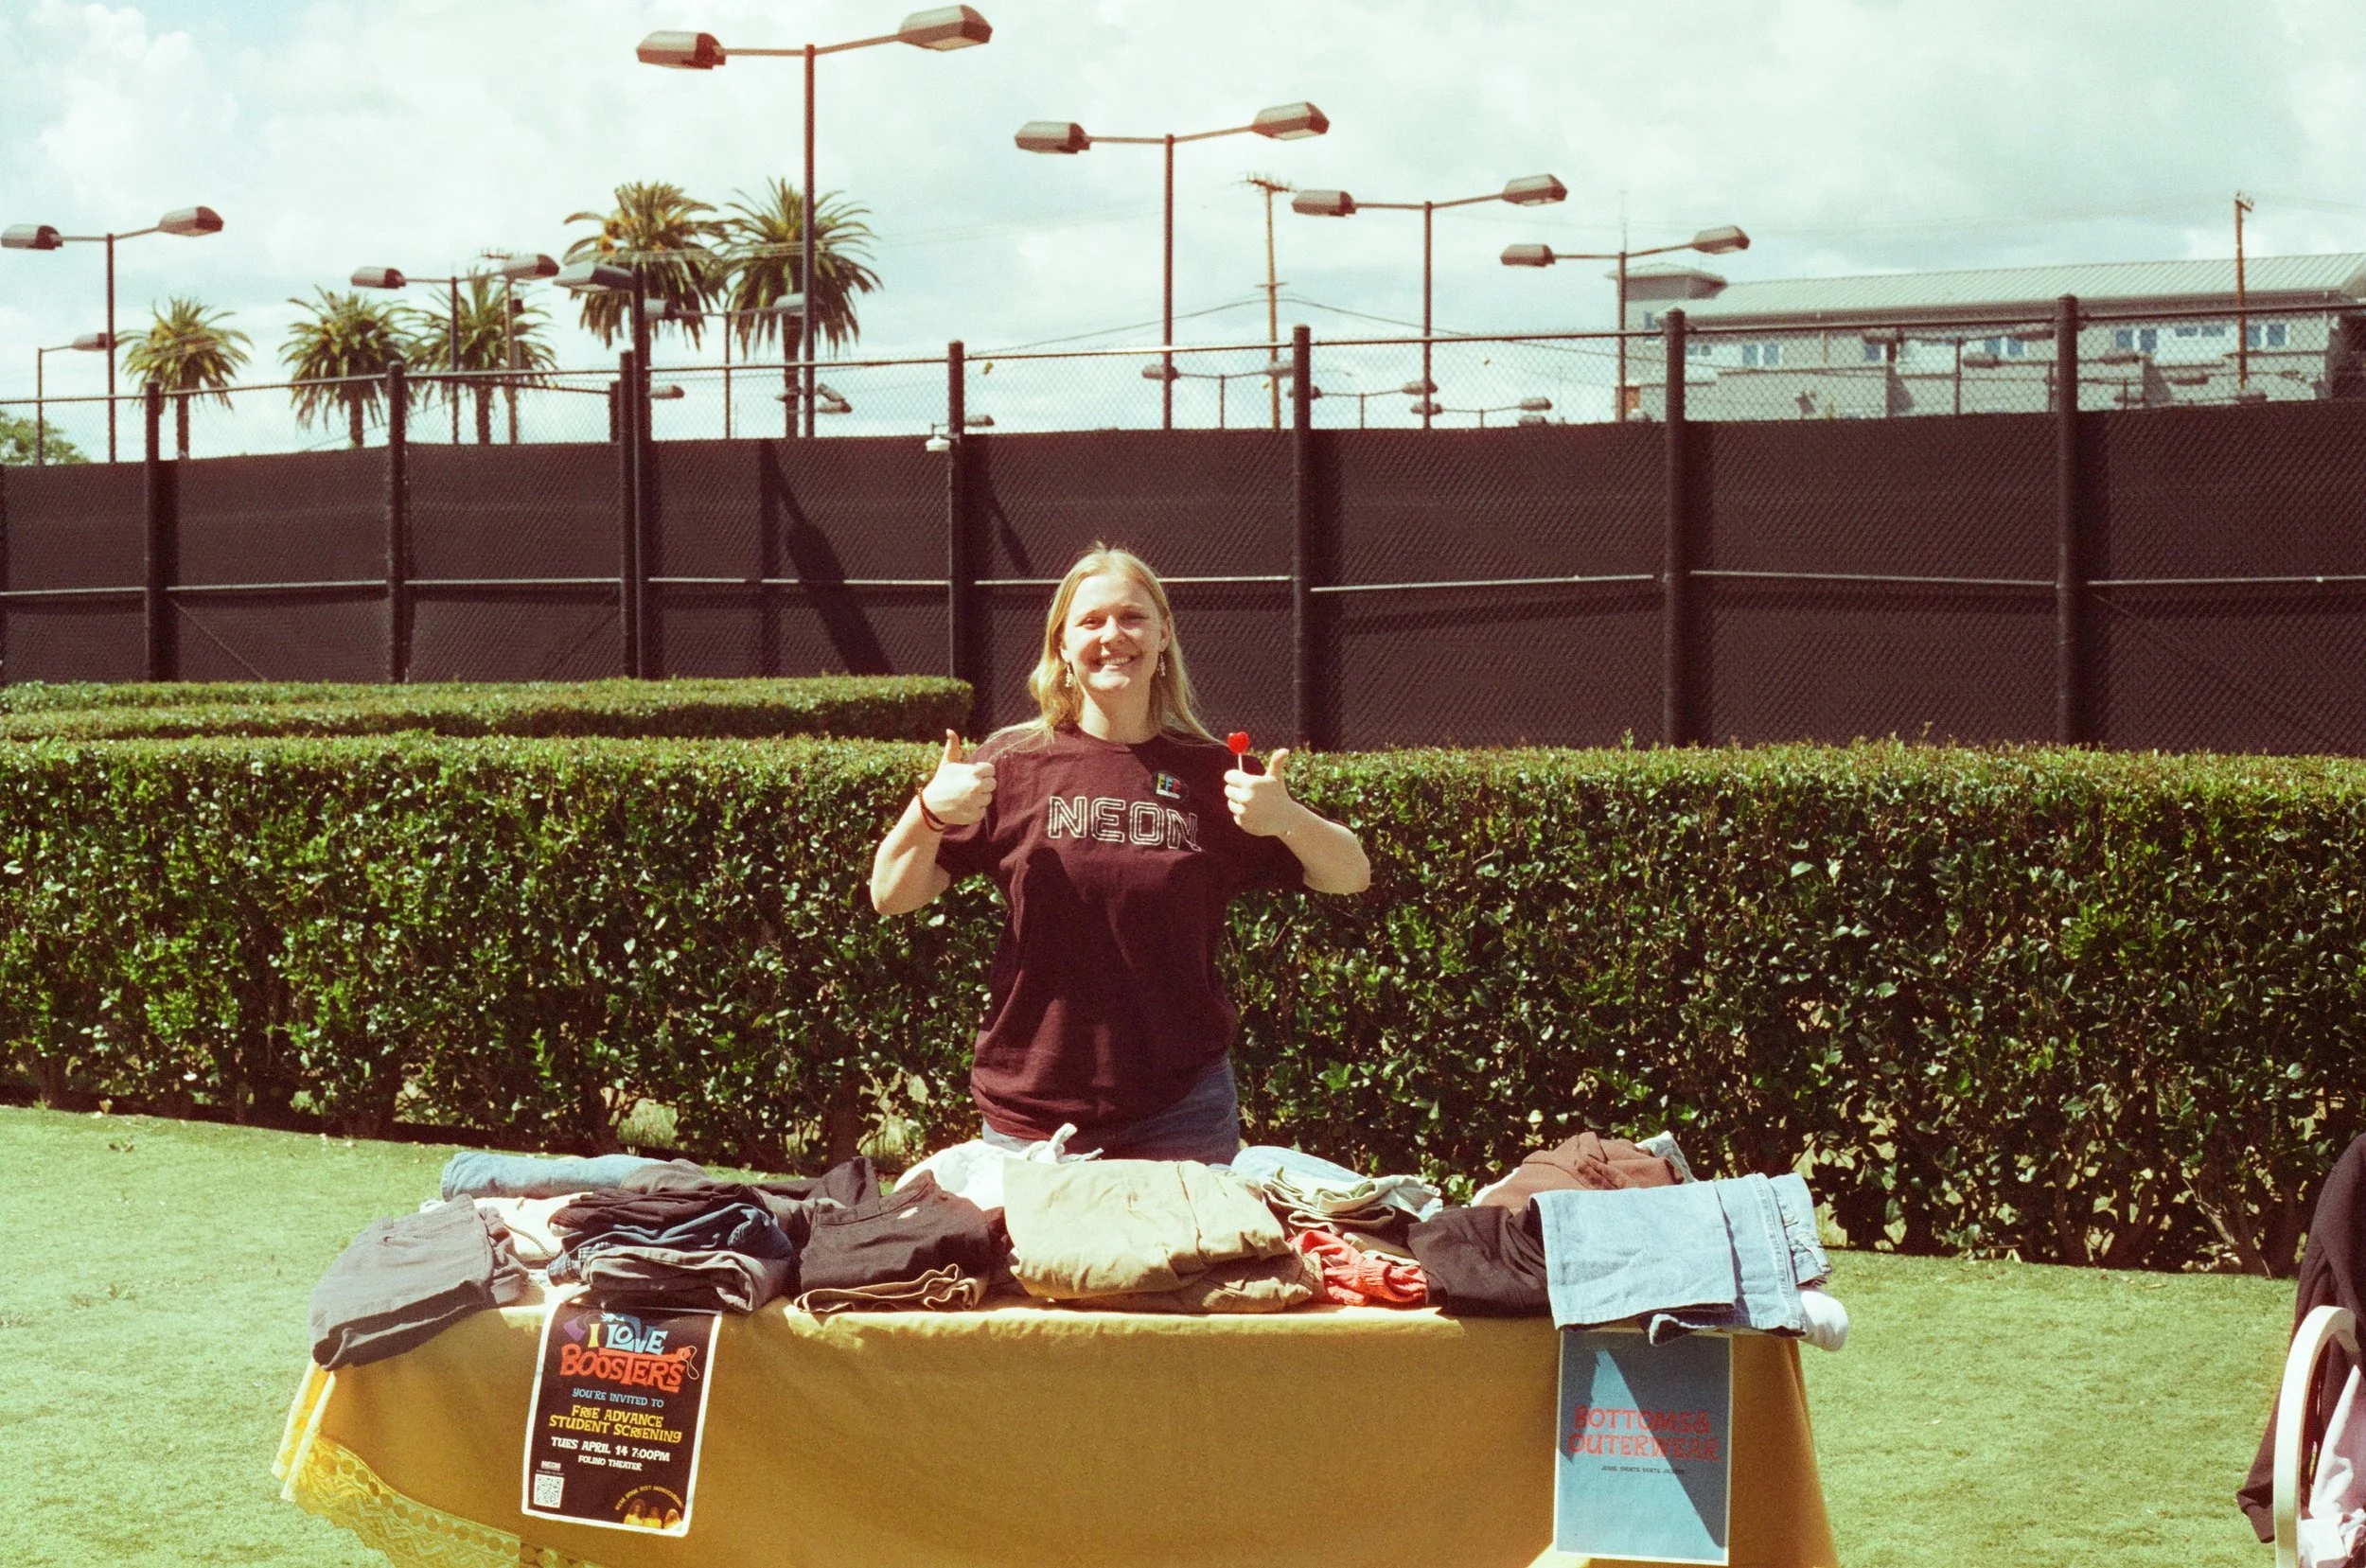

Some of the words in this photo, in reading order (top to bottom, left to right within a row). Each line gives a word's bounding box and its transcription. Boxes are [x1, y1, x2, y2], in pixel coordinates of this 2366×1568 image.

[1048, 795, 1202, 852] NEON
[588, 1323, 601, 1348] I
[606, 1323, 668, 1356] LOVE
[560, 1343, 689, 1393] BOOSTERS
[572, 1388, 607, 1401] YOU'RE
[609, 1393, 648, 1406] INVITED
[651, 1398, 665, 1408] TO
[549, 1415, 610, 1434] STUDENT
[613, 1423, 682, 1444] SCREENING
[571, 1404, 601, 1419] FREE
[604, 1409, 664, 1428] ADVANCE
[551, 1436, 579, 1450] TUES
[581, 1440, 610, 1454] APRIL
[615, 1445, 628, 1456] 14
[631, 1448, 671, 1462] 7:00PM
[1567, 1432, 1721, 1463] OUTERWEAR
[578, 1454, 606, 1467] FOLINO
[609, 1458, 643, 1471] THEATER
